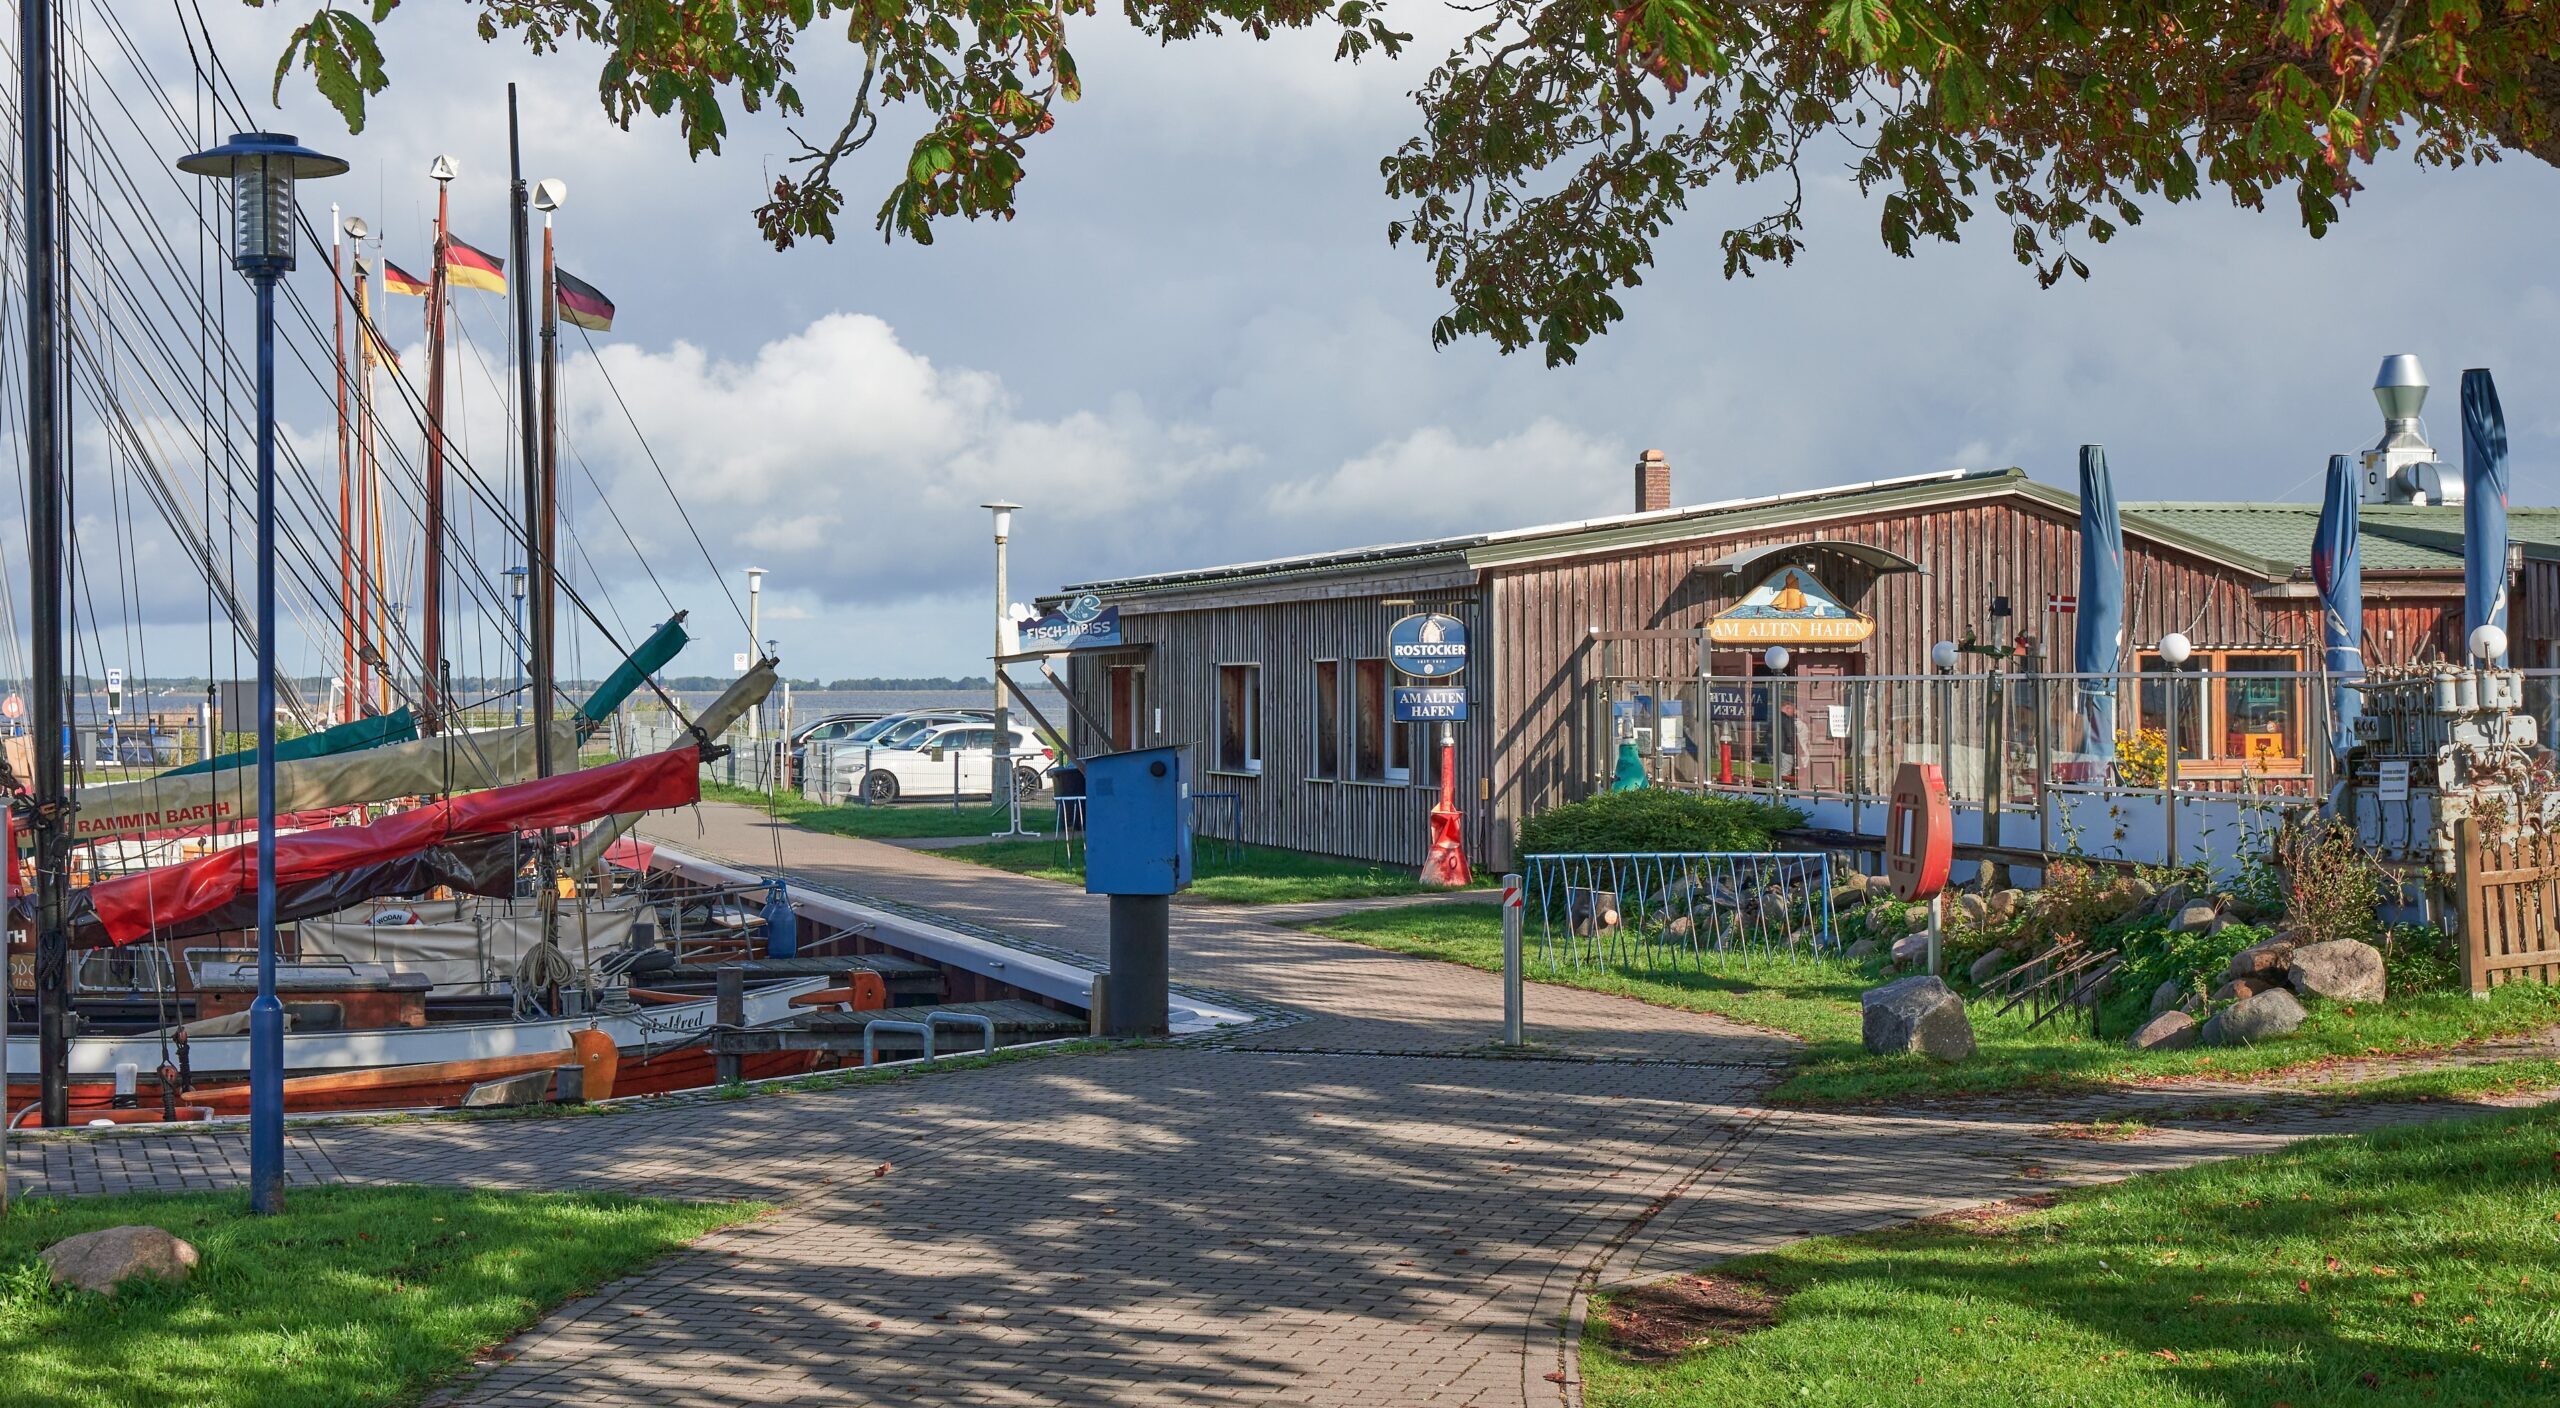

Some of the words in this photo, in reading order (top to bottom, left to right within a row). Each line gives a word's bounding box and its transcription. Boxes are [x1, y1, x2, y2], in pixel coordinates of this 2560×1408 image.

[1026, 621, 1111, 640] FISCH-IMBISS
[1713, 622, 1739, 637] AM
[1749, 622, 1800, 637] ALTEN
[1810, 622, 1867, 637] HAFEN
[1394, 644, 1466, 656] ROSTOCKER
[1400, 692, 1421, 704] AM
[1423, 691, 1464, 704] ALTEN
[1411, 705, 1455, 717] HAFEN
[78, 811, 160, 833] RAMMIN
[166, 802, 231, 824] BARTH
[376, 914, 403, 925] WODAN
